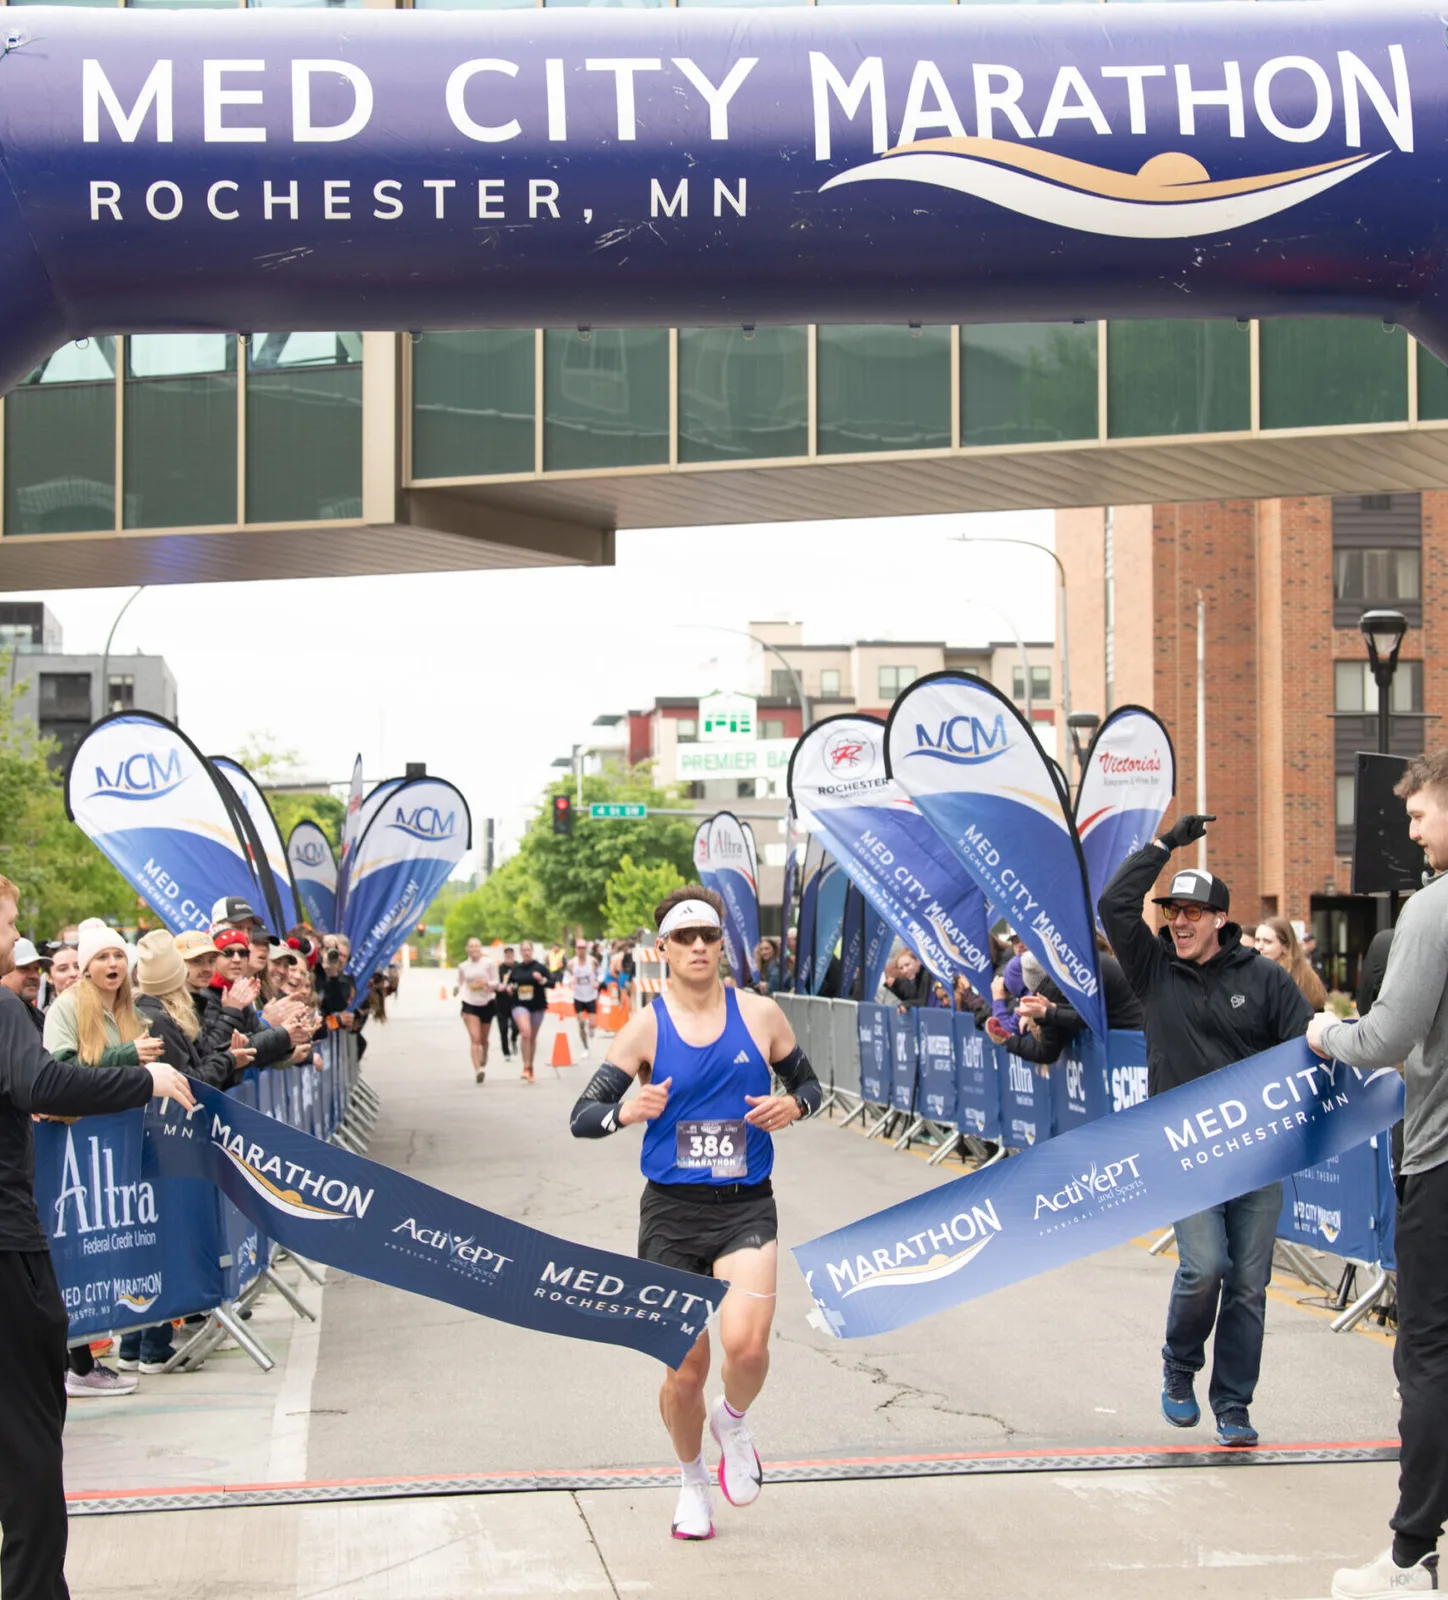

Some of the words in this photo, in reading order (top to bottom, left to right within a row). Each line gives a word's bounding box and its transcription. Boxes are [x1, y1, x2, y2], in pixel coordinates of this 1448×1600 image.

[82, 58, 374, 143] MED
[445, 57, 759, 142] CITY
[809, 44, 1414, 161] MARATHON
[90, 179, 593, 224] ROCHESTER,
[650, 178, 747, 218] MN
[916, 713, 1008, 755] MCM
[95, 747, 182, 791] MCM
[681, 751, 758, 772] PREMIER
[767, 749, 789, 769] BA
[1099, 749, 1161, 774] Victoria's
[818, 778, 890, 795] ROCHESTER
[395, 806, 455, 836] MCM
[714, 829, 743, 854] Altra
[143, 858, 180, 899] MED
[180, 899, 212, 930] CIT
[860, 829, 895, 866] MED
[894, 867, 931, 902] CITY
[924, 900, 991, 974] MARATHON
[964, 824, 1000, 867] MED
[1000, 868, 1039, 912] CITY
[1031, 910, 1099, 998] MARATHON
[907, 920, 954, 977] MARATHO
[1066, 1060, 1086, 1102] GPC
[1112, 1066, 1149, 1113] SCHE
[1163, 1099, 1248, 1152] MED
[1262, 1058, 1337, 1111] CITY
[163, 1123, 194, 1139] MN
[689, 1135, 734, 1158] 386
[1180, 1111, 1316, 1172] ROCHESTER,
[1321, 1092, 1349, 1113] MN
[53, 1124, 159, 1238] Altra
[211, 1113, 375, 1220] MARATHON
[688, 1158, 737, 1168] MARATHON
[1115, 1179, 1144, 1198] Sports
[83, 1234, 110, 1255] Federal
[111, 1231, 134, 1251] Credit
[134, 1229, 157, 1247] Union
[825, 1199, 1003, 1292] MARATHON
[85, 1280, 111, 1303] CITY
[113, 1271, 162, 1302] MARATHON
[540, 1261, 625, 1297] MED
[638, 1285, 722, 1325] CITY
[533, 1286, 667, 1326] ROCHESTER,
[680, 1321, 700, 1340] M
